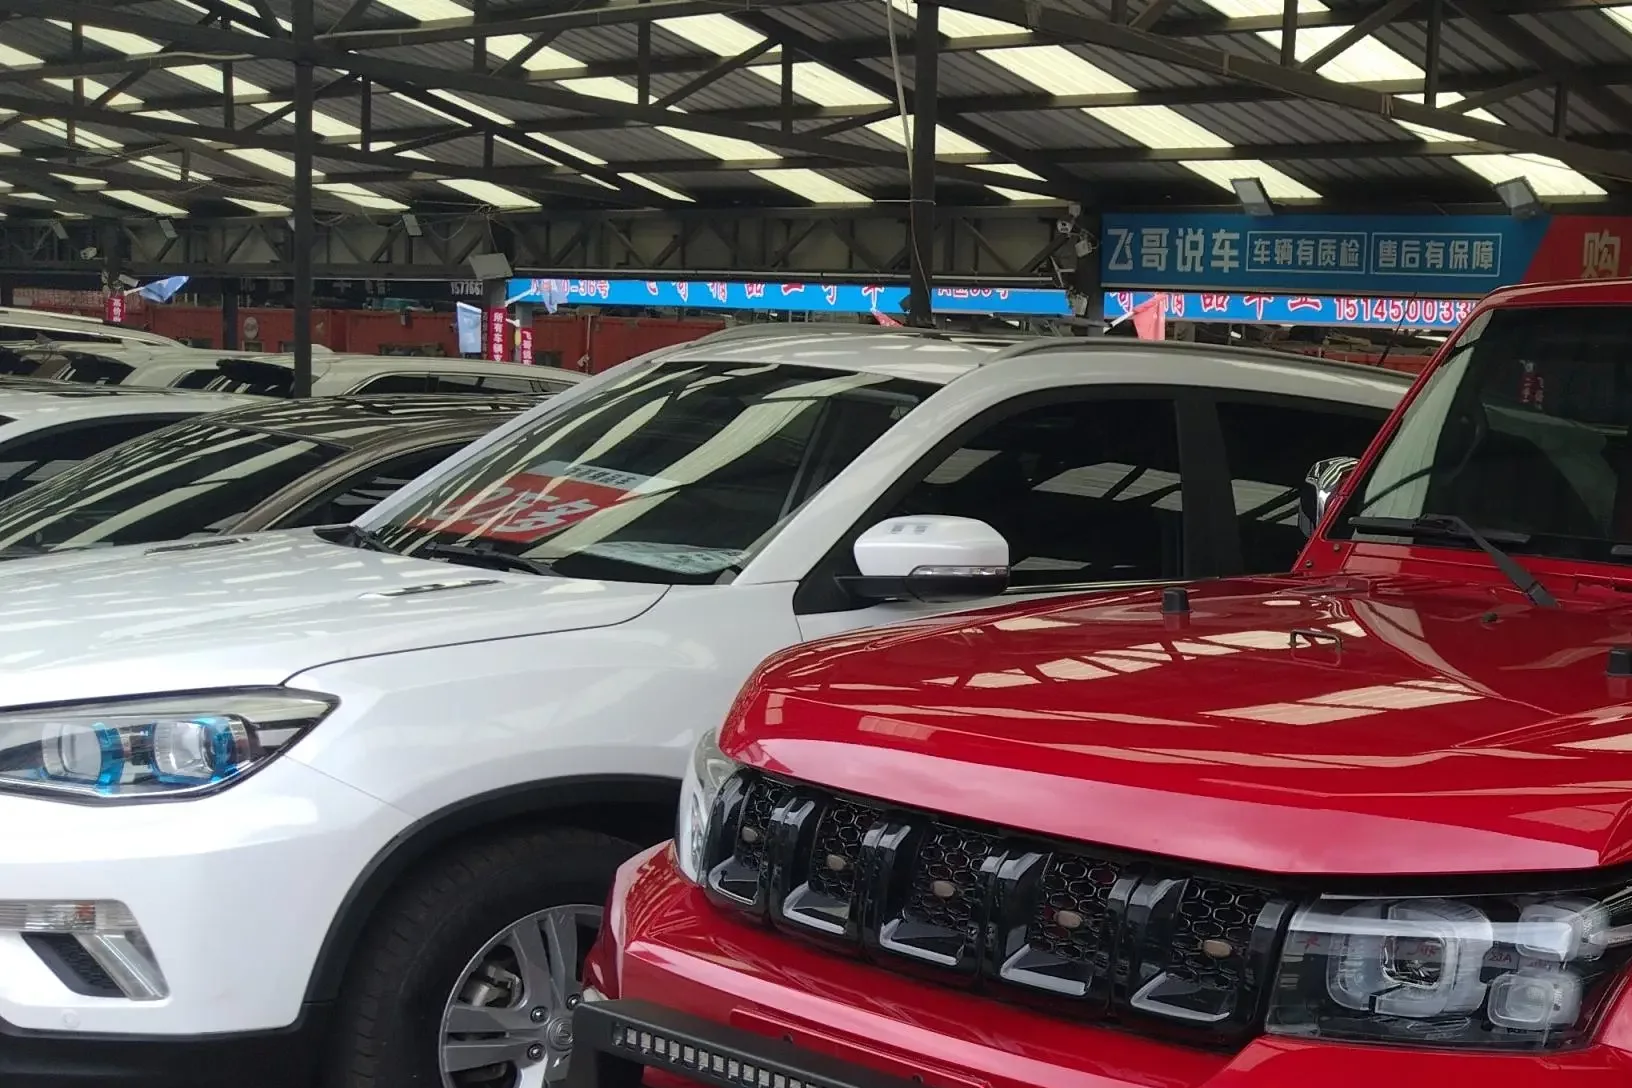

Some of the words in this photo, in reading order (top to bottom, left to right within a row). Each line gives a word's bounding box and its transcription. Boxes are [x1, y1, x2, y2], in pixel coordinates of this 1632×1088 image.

[1108, 228, 1240, 274] 飞哥说车
[1253, 237, 1360, 268] 车辆有质检
[1377, 237, 1494, 271] 售后有保障
[1334, 296, 1477, 324] 151450033
